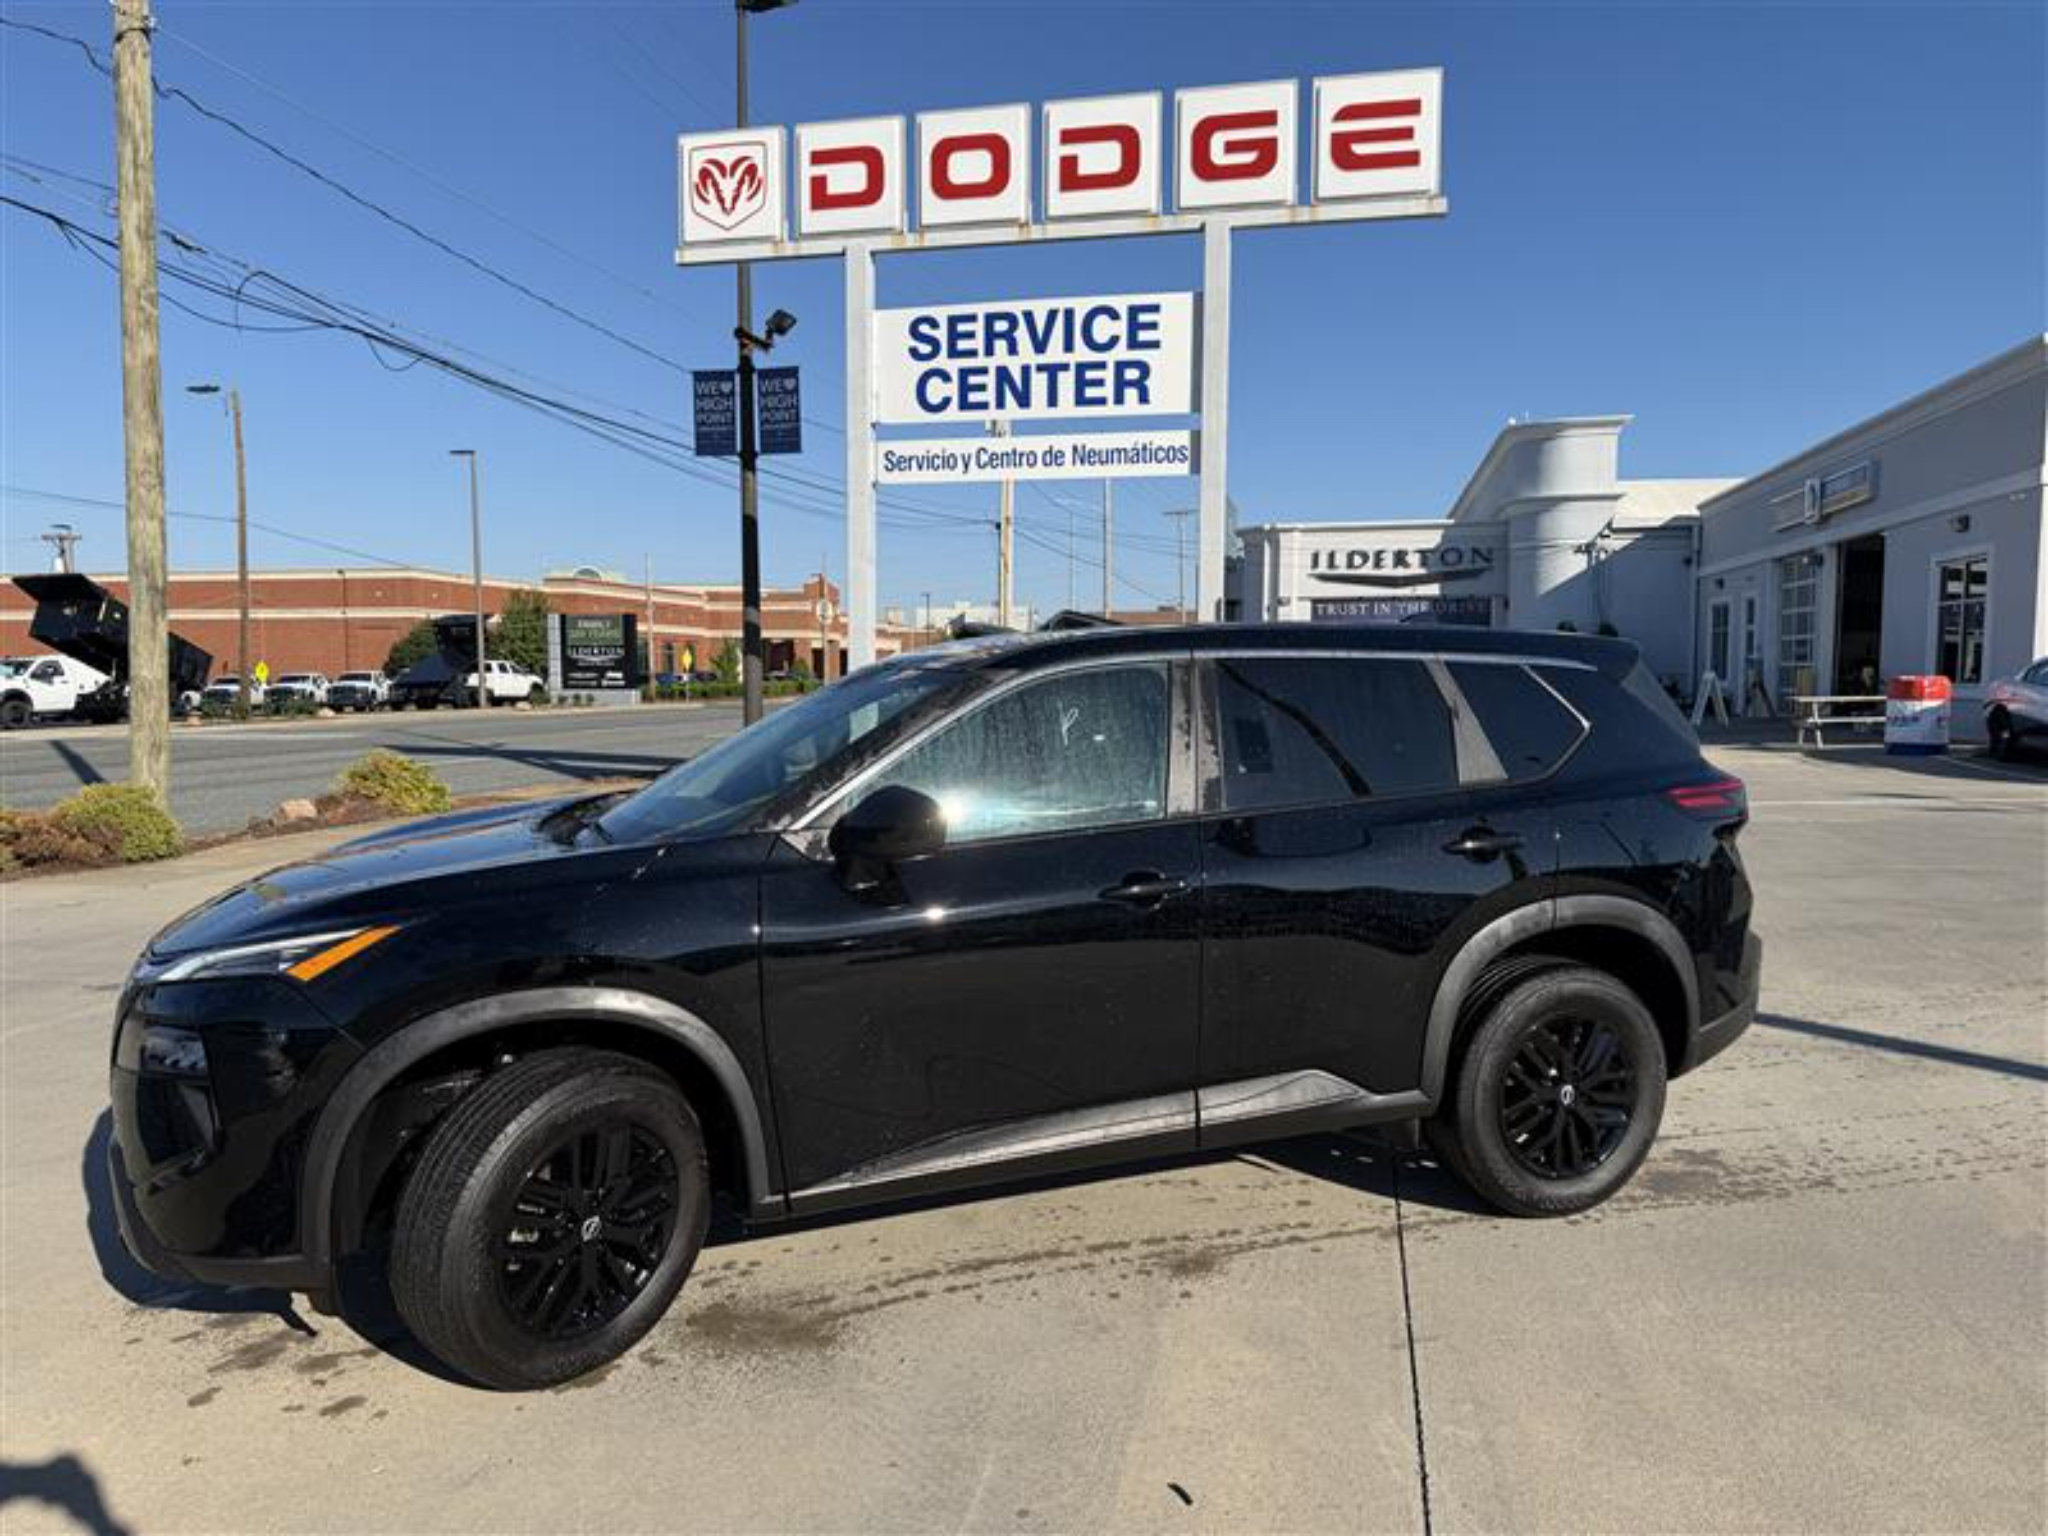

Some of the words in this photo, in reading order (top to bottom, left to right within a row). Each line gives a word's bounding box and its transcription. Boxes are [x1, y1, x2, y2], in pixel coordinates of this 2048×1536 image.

[809, 98, 1422, 211] DODGE
[907, 303, 1162, 362] SERVICE
[915, 359, 1151, 414] CENTER
[883, 449, 958, 473] Servicio
[961, 454, 973, 474] y
[975, 447, 1038, 469] Centro
[1041, 445, 1066, 468] de
[1072, 440, 1190, 468] Neumáticos
[1311, 547, 1495, 569] ILDERTON
[1316, 603, 1370, 616] TRUST
[1374, 602, 1391, 615] IN
[1400, 601, 1429, 615] THE
